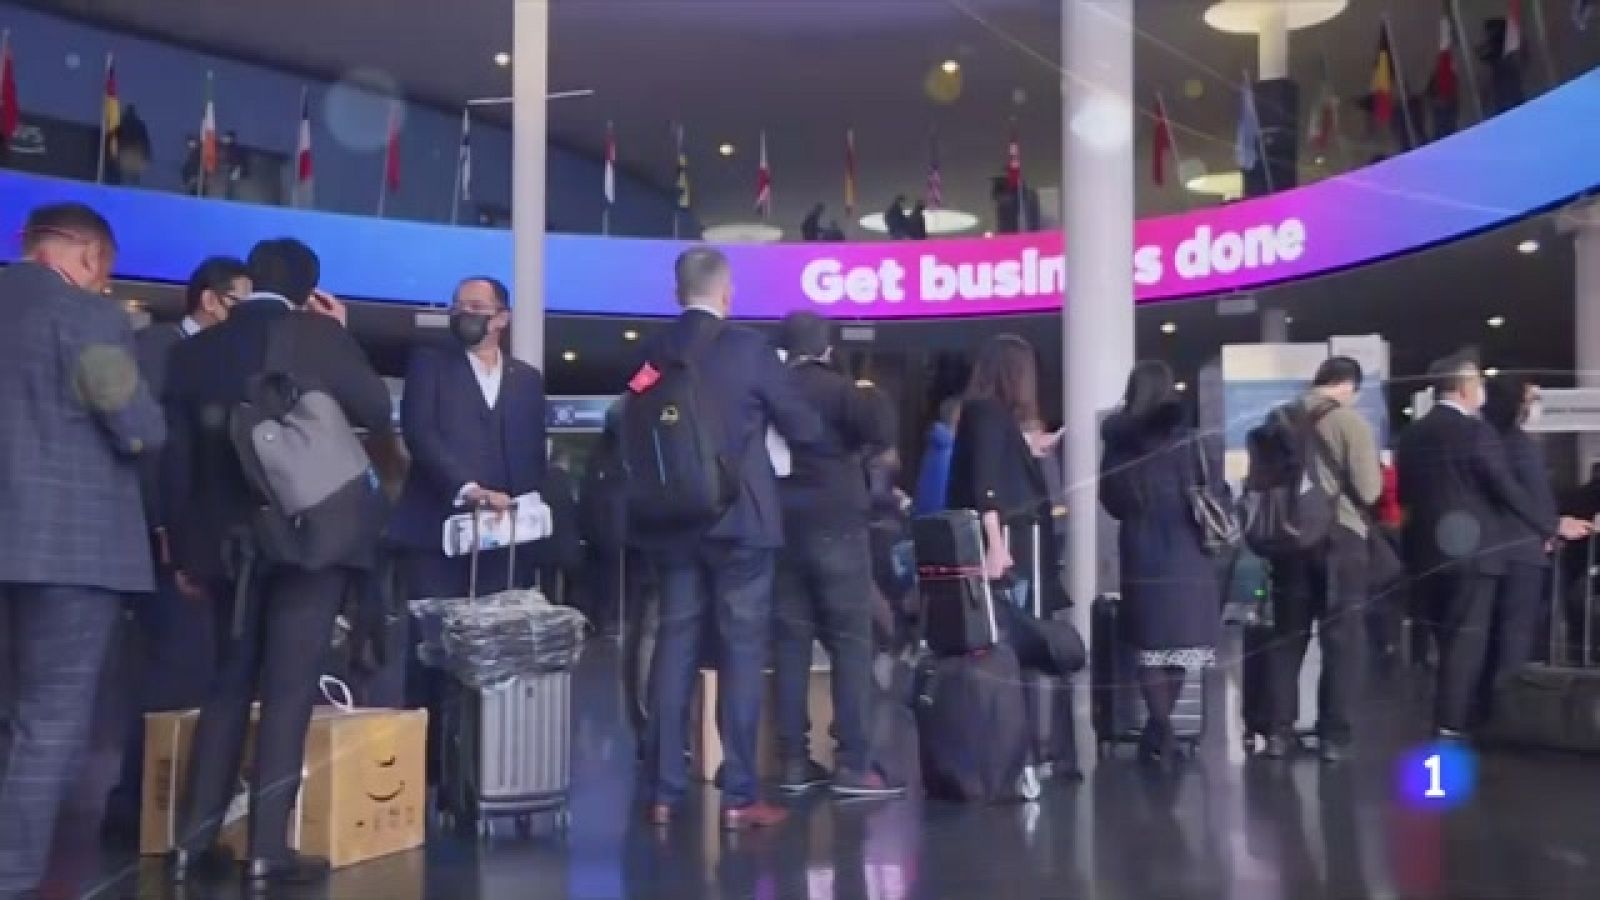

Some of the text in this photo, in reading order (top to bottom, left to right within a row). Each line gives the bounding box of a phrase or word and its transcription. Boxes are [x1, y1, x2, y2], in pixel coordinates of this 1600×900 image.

[801, 219, 1306, 303] Get busins done
